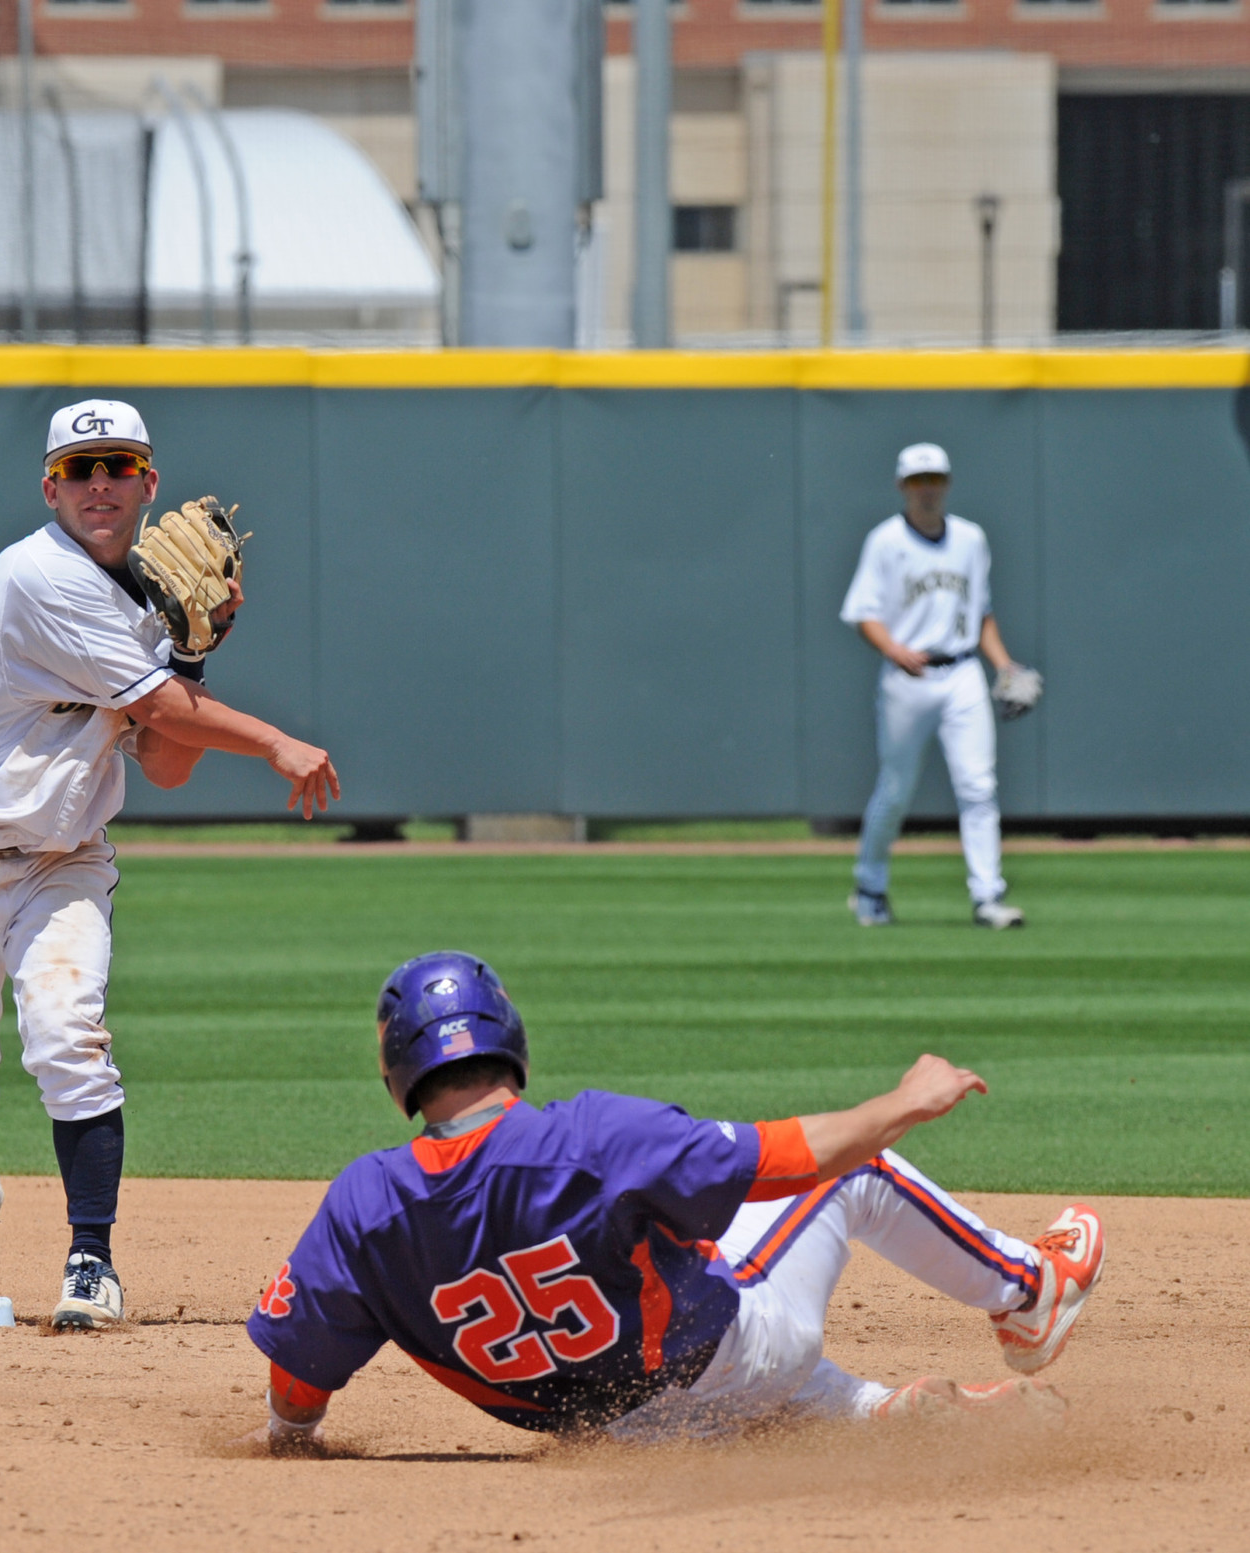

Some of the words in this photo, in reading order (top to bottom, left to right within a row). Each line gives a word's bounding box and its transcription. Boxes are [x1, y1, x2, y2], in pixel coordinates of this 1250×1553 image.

[72, 410, 114, 436] GT
[438, 1018, 469, 1038] ACC
[430, 1233, 621, 1384] 25
